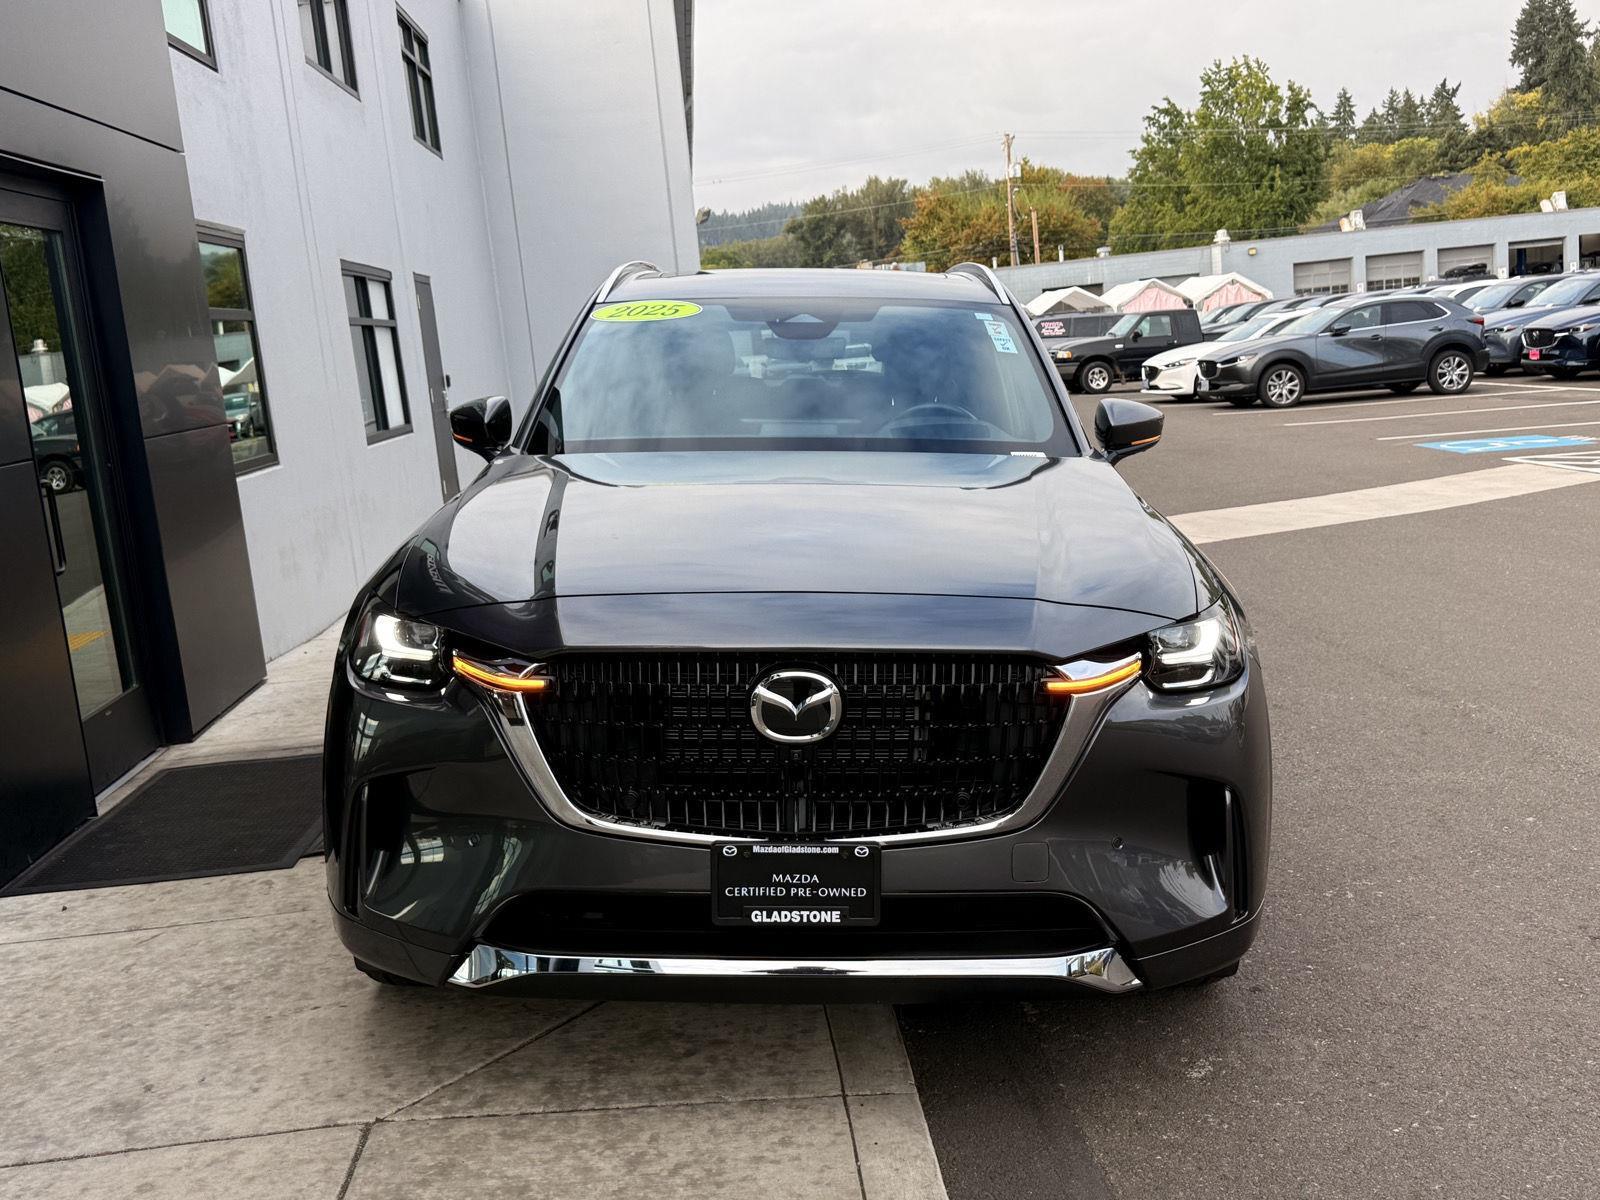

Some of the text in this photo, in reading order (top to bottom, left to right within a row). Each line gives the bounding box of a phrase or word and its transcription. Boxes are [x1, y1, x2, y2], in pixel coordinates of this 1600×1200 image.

[607, 304, 686, 318] 2025
[752, 845, 839, 854] MazdaofGladstone.com
[772, 874, 820, 884] MAZDA
[725, 887, 867, 897] CERTIFIED PRE-OWNED
[751, 910, 841, 923] GLADSTONE
